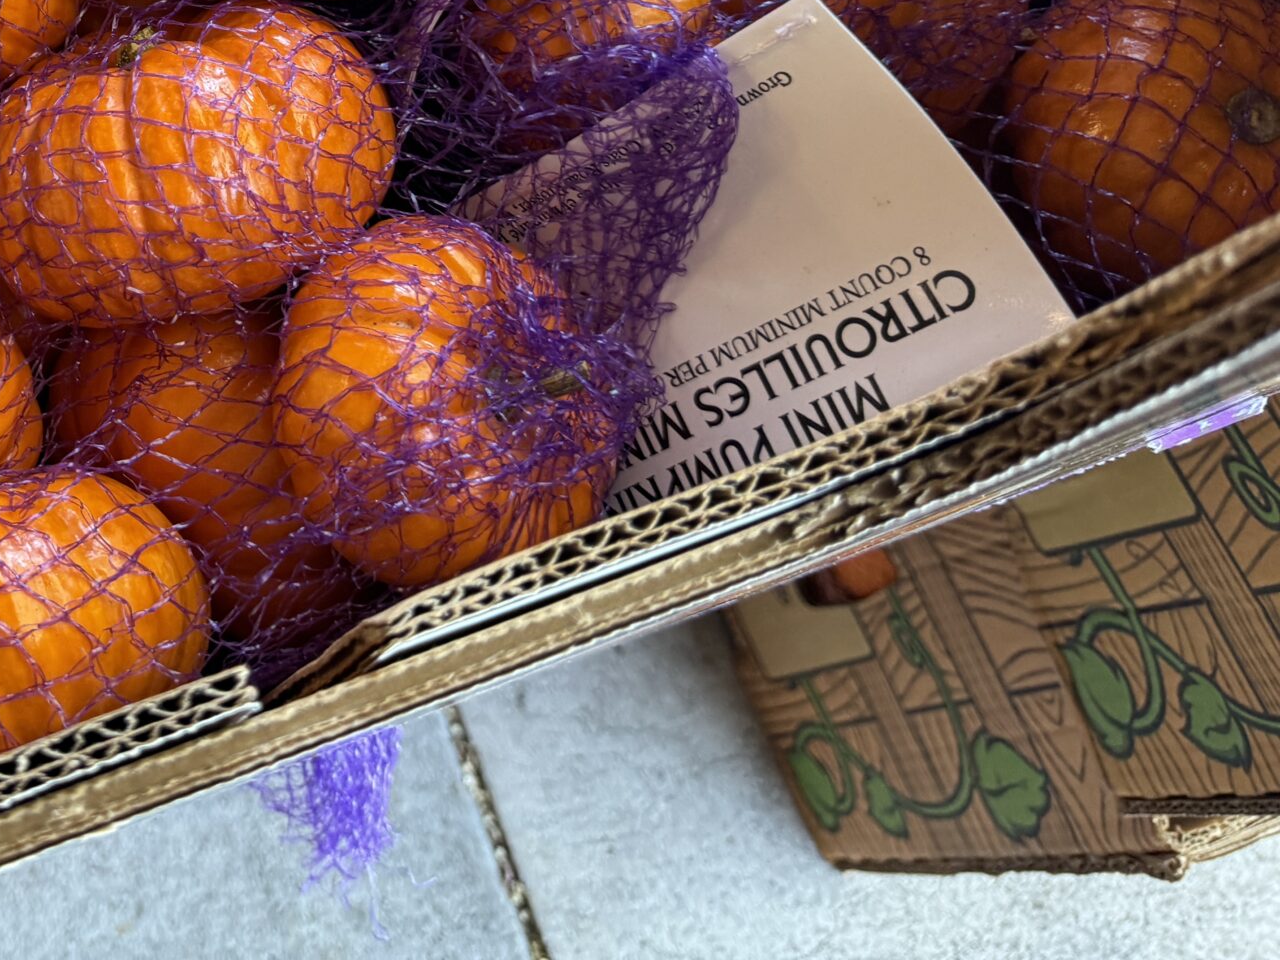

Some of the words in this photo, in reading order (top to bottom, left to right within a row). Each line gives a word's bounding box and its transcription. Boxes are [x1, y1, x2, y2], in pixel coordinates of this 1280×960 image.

[736, 71, 792, 107] Grown
[831, 256, 912, 312] COUNT
[912, 246, 932, 267] 8
[693, 270, 977, 428] CITROUILLES
[715, 297, 828, 368] MINIMUM
[665, 356, 709, 388] PER
[617, 401, 695, 471] MIN
[778, 372, 891, 449] MINI
